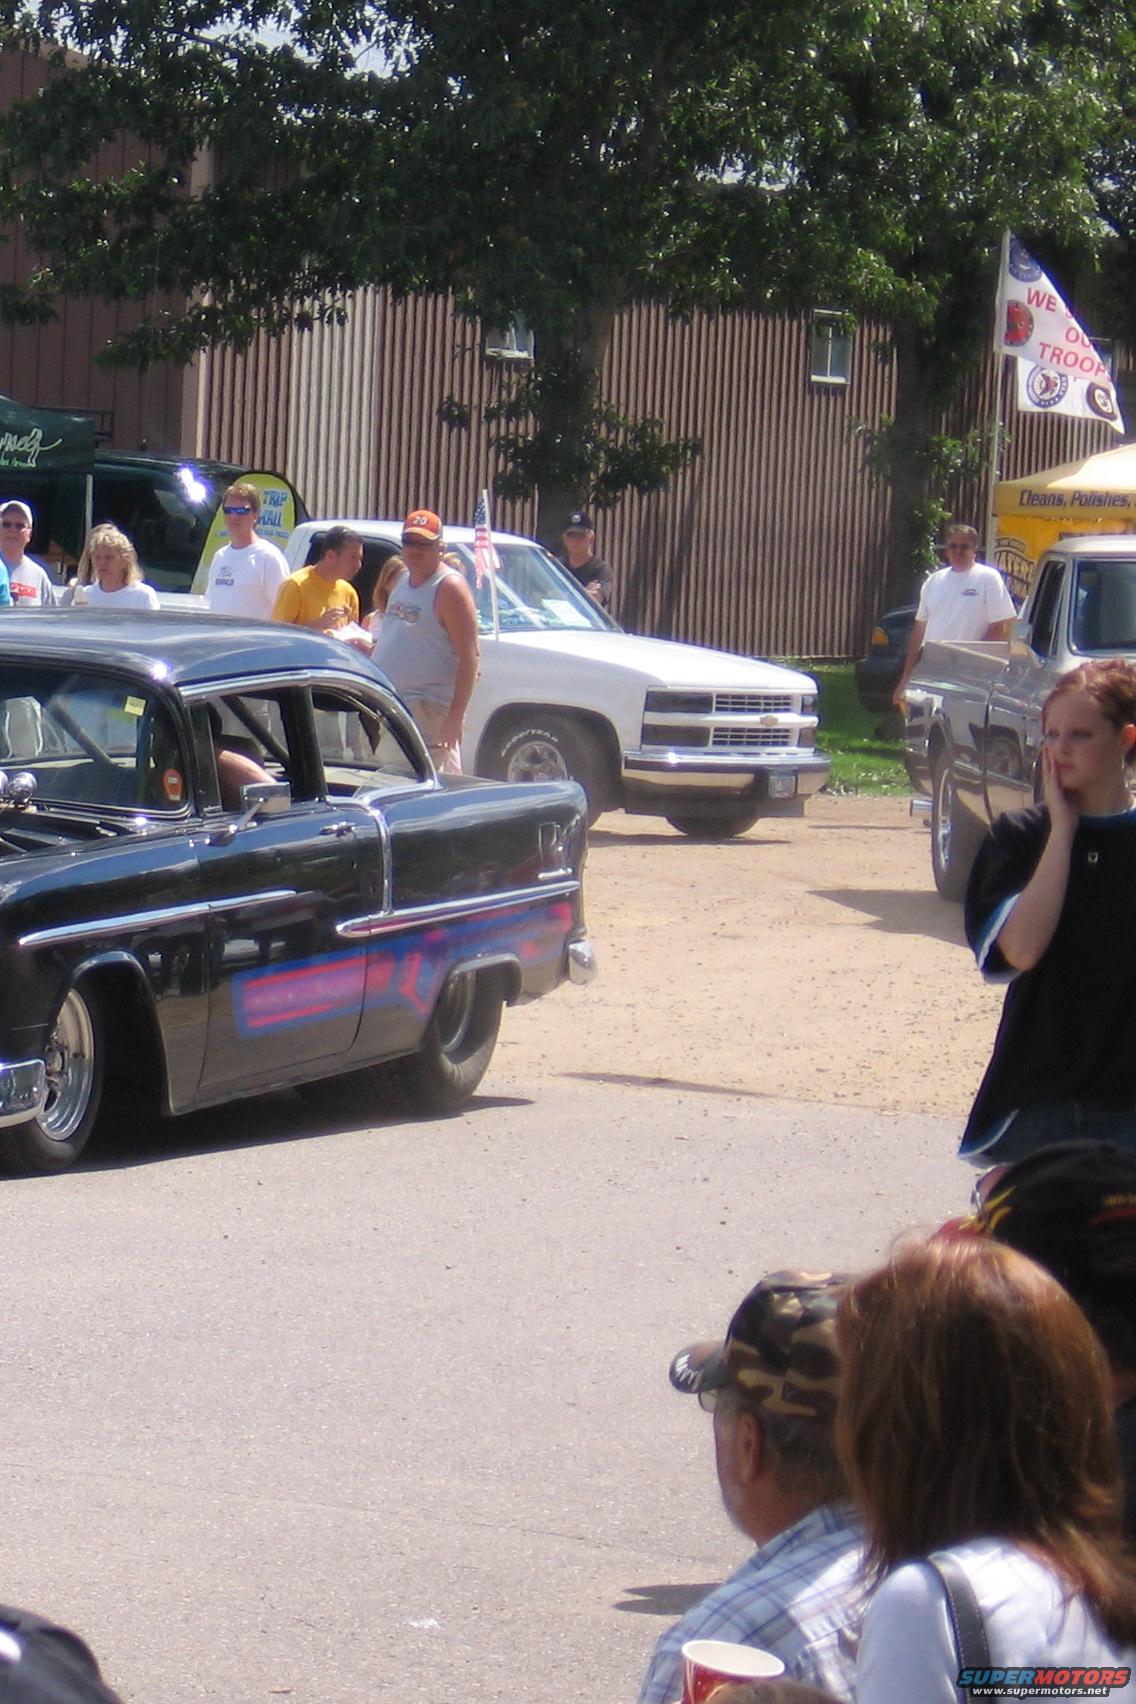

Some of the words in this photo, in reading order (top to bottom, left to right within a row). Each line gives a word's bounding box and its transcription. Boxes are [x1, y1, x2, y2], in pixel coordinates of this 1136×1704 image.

[1026, 287, 1058, 313] WE
[1019, 489, 1067, 507] Cleans,
[1070, 490, 1131, 508] Polishes,
